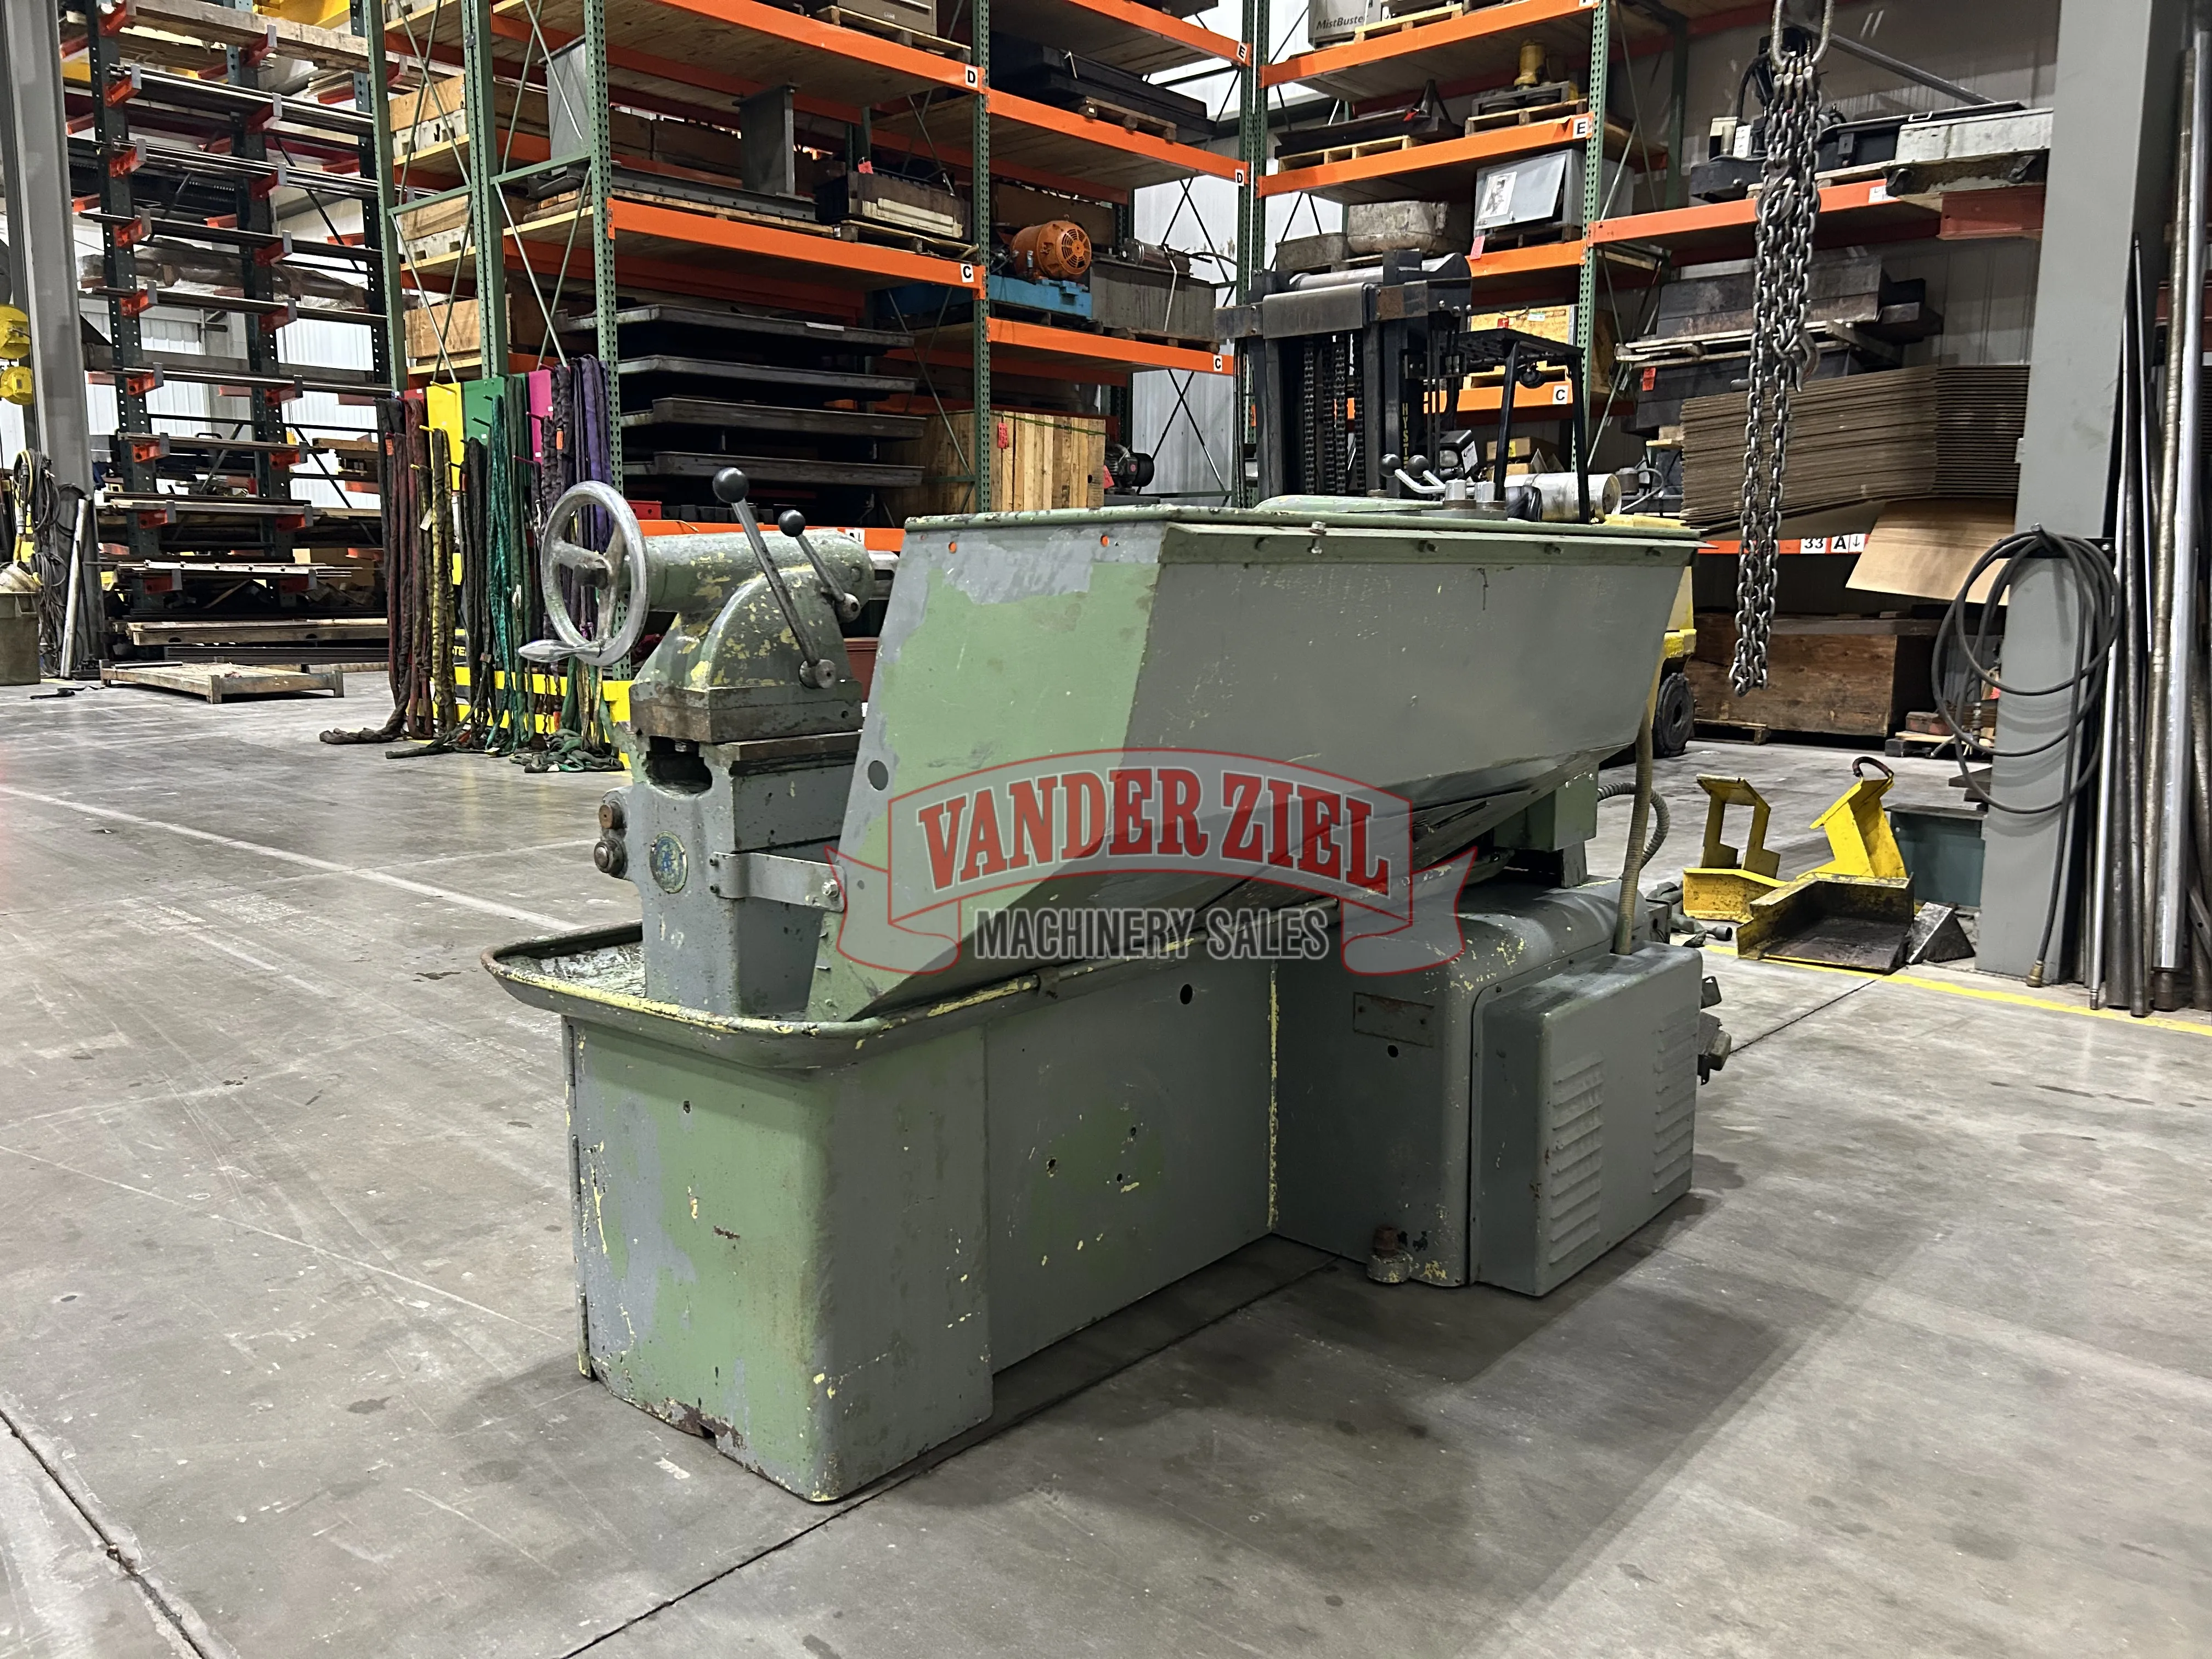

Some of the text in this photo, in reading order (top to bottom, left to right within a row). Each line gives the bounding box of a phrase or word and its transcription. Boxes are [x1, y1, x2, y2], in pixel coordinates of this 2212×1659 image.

[1316, 15, 1369, 30] MistBuste
[1238, 45, 1245, 59] E
[967, 70, 976, 84] D
[1576, 122, 1586, 134] E
[1237, 172, 1243, 183] D
[963, 266, 972, 279] C
[1215, 358, 1221, 369] C
[1555, 390, 1566, 401] C
[1833, 535, 1847, 549] A
